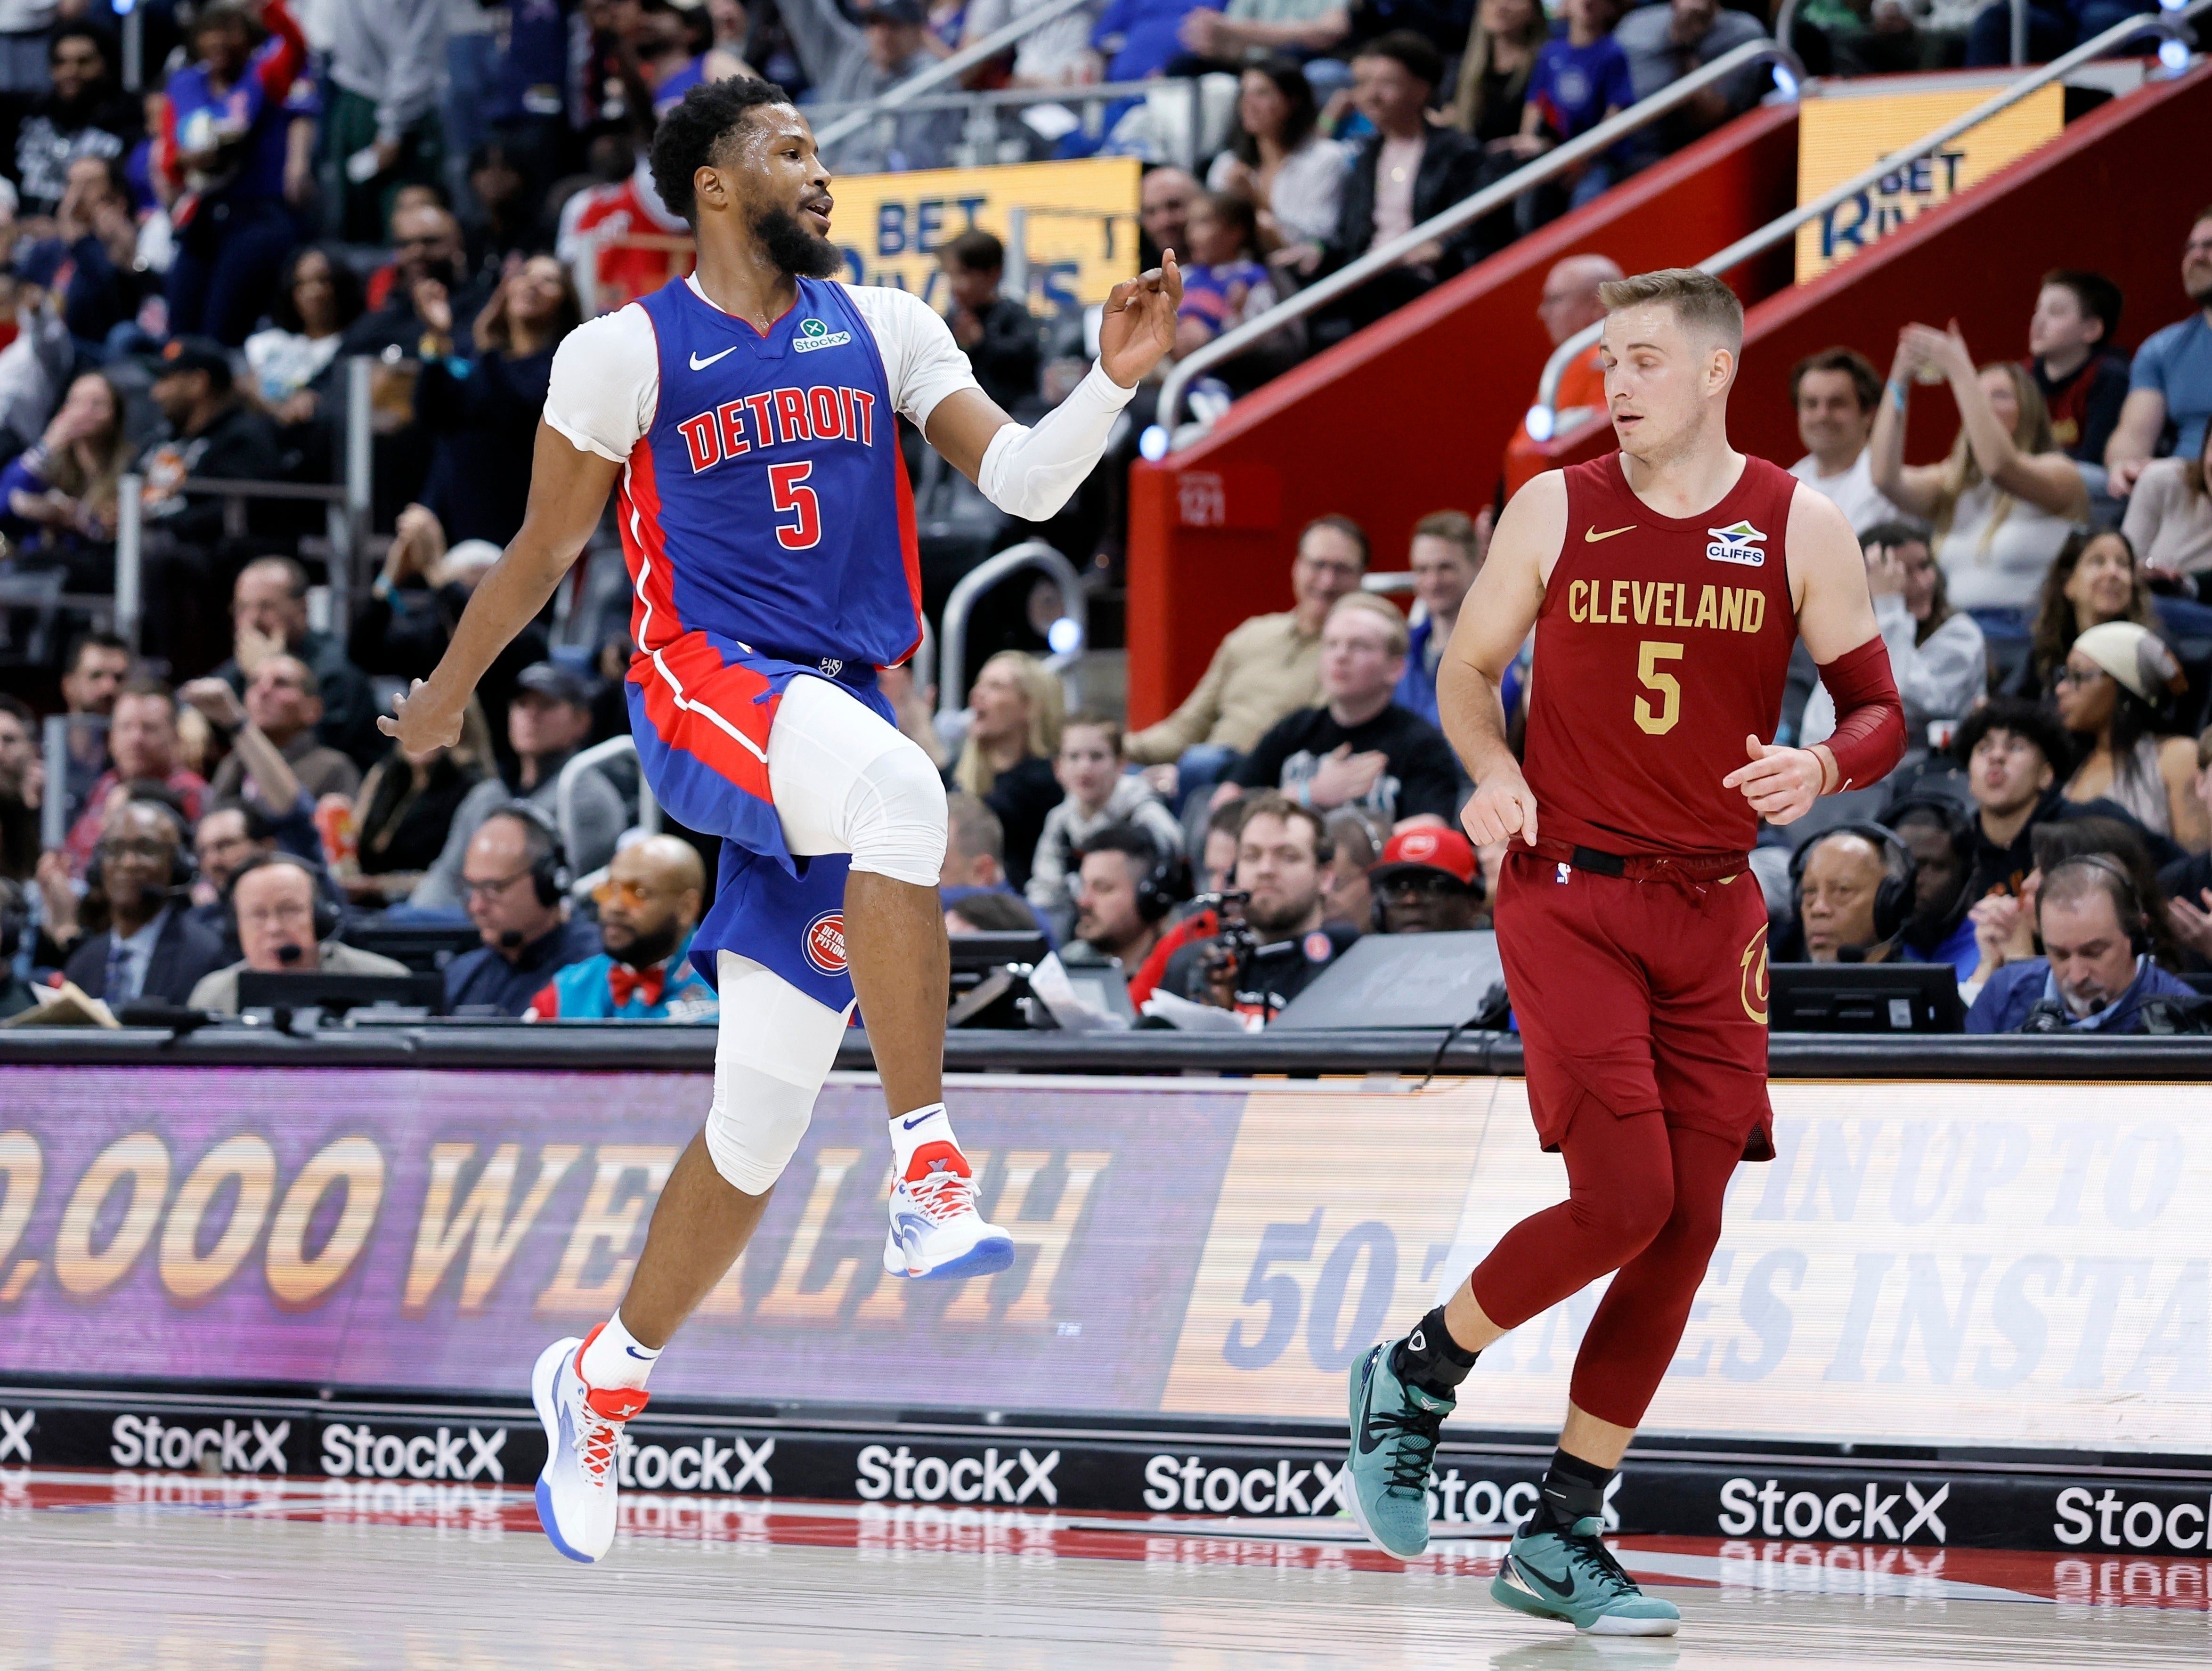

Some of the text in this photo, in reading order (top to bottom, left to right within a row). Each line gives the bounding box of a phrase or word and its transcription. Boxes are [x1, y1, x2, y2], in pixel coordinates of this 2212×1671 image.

[795, 333, 848, 351] StockX
[677, 386, 875, 474] DETROIT
[767, 460, 822, 551] 5
[1708, 546, 1763, 563] CLIFFS
[1569, 579, 1766, 633] CLEVELAND
[1634, 640, 1684, 735] 5
[1889, 1120, 2031, 1225] UP
[2044, 1121, 2184, 1231] TO
[1223, 1207, 1398, 1372] 50
[111, 1414, 291, 1474] StockX
[320, 1424, 507, 1482] StockX
[616, 1435, 776, 1493] tockX
[855, 1445, 1060, 1506] StockX
[1718, 1477, 1950, 1543] StockX
[2052, 1486, 2212, 1550] Stoc
